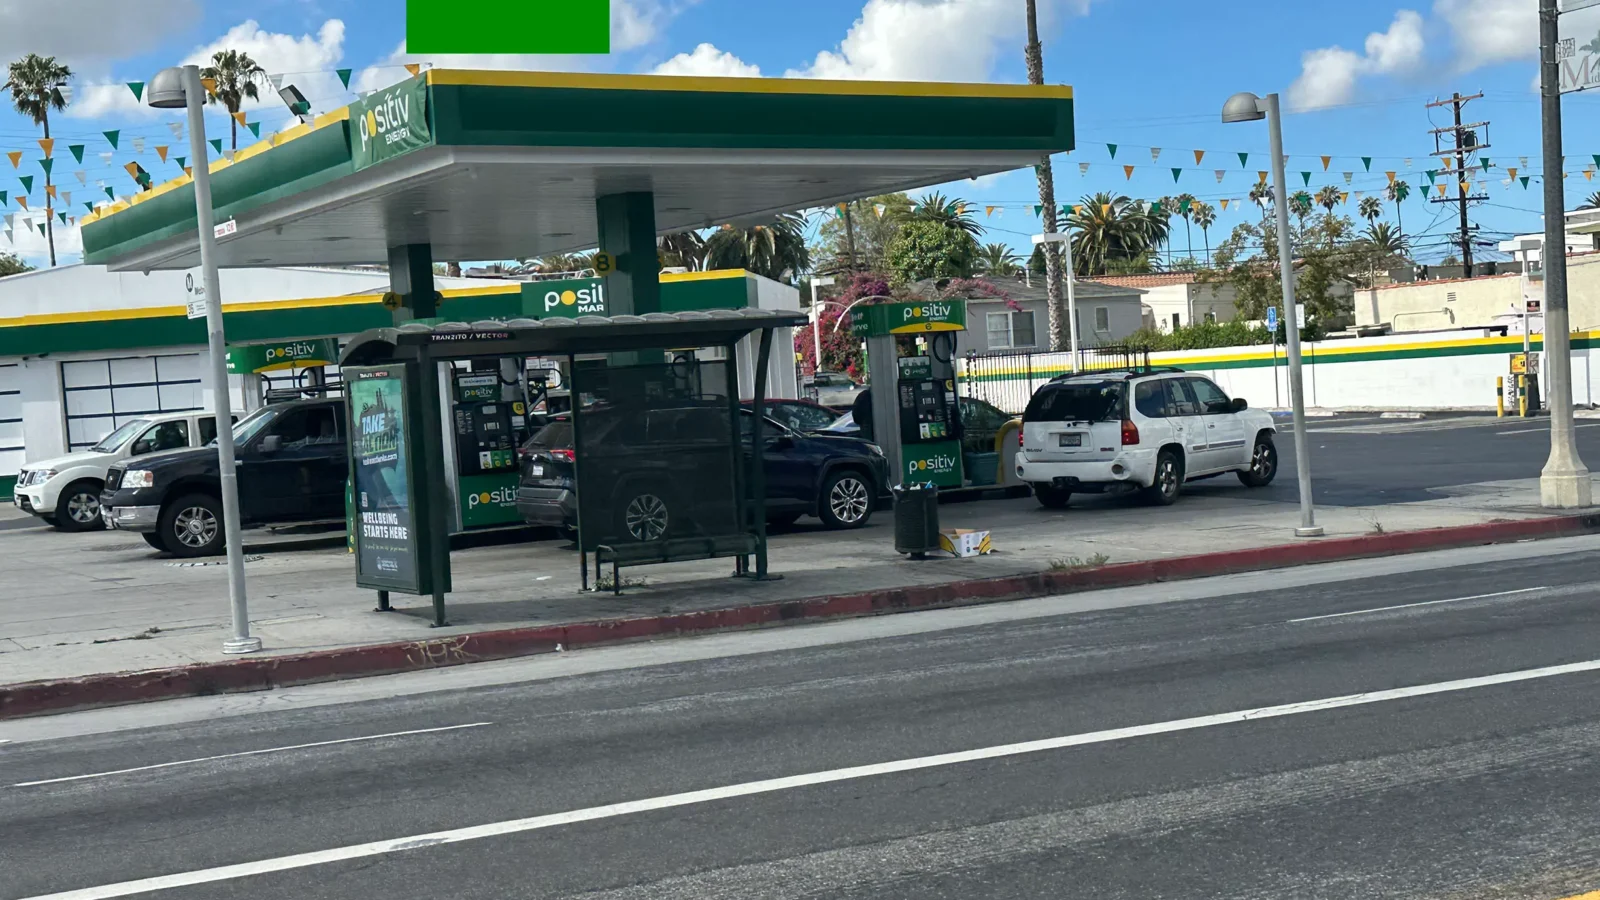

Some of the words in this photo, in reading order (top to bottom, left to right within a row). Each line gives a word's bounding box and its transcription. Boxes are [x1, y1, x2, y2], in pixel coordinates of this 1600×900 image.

[360, 88, 409, 152] positiv
[385, 126, 411, 145] ENERGY
[596, 255, 610, 271] 8
[385, 293, 398, 307] 4
[904, 302, 951, 321] positiv
[925, 322, 932, 330] 6
[266, 342, 315, 361] positiv
[464, 387, 493, 398] positiv
[362, 413, 385, 435] TAKE
[909, 454, 955, 474] positiv
[468, 485, 519, 509] positi
[362, 511, 398, 525] WELLBEING
[363, 525, 388, 538] STARTS
[389, 526, 408, 540] HERE
